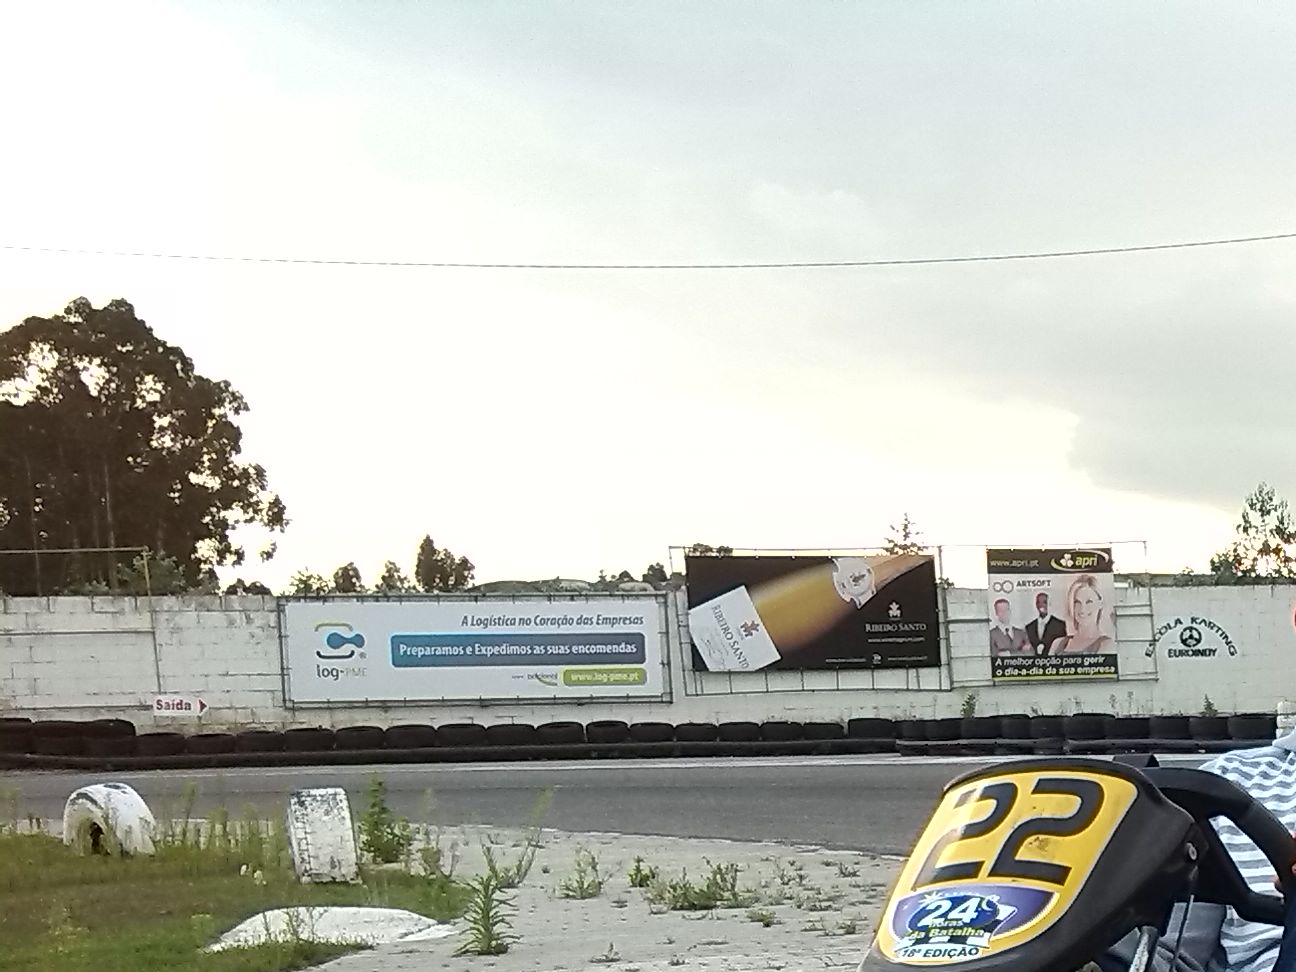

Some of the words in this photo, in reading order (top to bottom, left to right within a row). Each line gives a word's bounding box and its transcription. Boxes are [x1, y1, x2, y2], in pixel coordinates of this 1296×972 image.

[1075, 554, 1098, 569] apri
[1016, 580, 1051, 588] ARTSOFT
[461, 615, 469, 627] A
[470, 614, 516, 630] Logística
[518, 617, 532, 626] no
[534, 614, 575, 629] Coração
[576, 614, 594, 626] das
[596, 614, 644, 628] Empresas
[712, 604, 734, 641] RIBEIRO
[865, 623, 898, 633] RIBEIRO
[899, 622, 927, 632] SANTO
[1190, 616, 1238, 657] KARTING
[399, 643, 464, 659] Preparamos
[465, 646, 473, 655] e
[474, 642, 532, 658] Expedimos
[533, 645, 546, 655] as
[547, 644, 571, 655] suas
[571, 642, 638, 655] encomendas
[1167, 648, 1218, 658] EUROINDY
[994, 657, 1003, 666] A
[1004, 657, 1034, 666] melhor
[1035, 657, 1062, 668] opção
[1063, 657, 1081, 667] para
[1083, 655, 1106, 666] gerir
[1004, 667, 1044, 676] dia-a-dia
[1045, 666, 1057, 675] da
[1059, 667, 1075, 675] sua
[1077, 666, 1116, 676] empresa
[911, 776, 1105, 892] 22
[917, 897, 981, 927] 24
[929, 926, 985, 938] Batalha
[922, 947, 980, 959] EDIÇÃO
